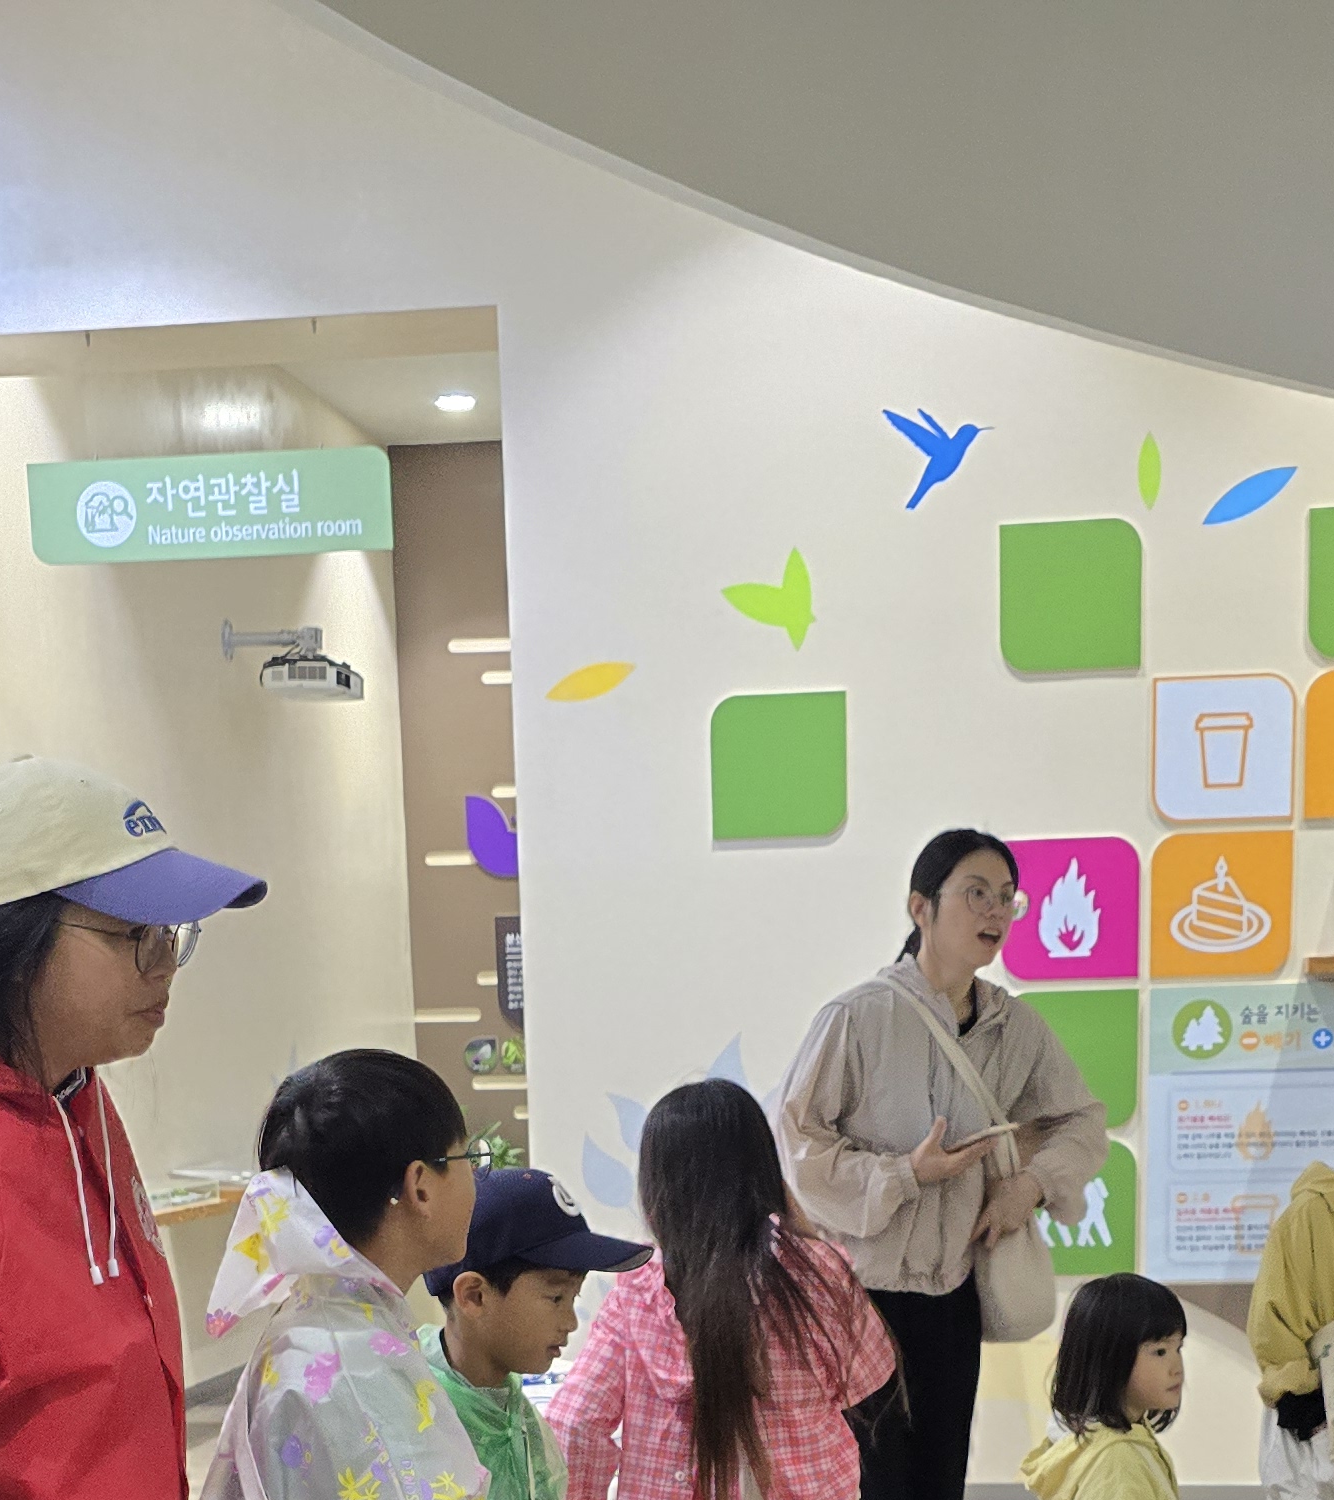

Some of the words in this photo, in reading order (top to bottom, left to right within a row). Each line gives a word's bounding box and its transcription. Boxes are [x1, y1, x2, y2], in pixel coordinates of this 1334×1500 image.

[145, 469, 301, 519] 자연관찰실
[147, 523, 207, 545] Nature
[210, 517, 313, 542] observation
[316, 516, 362, 537] room
[1240, 1003, 1269, 1025] 숲을
[1274, 1002, 1320, 1023] 지키는
